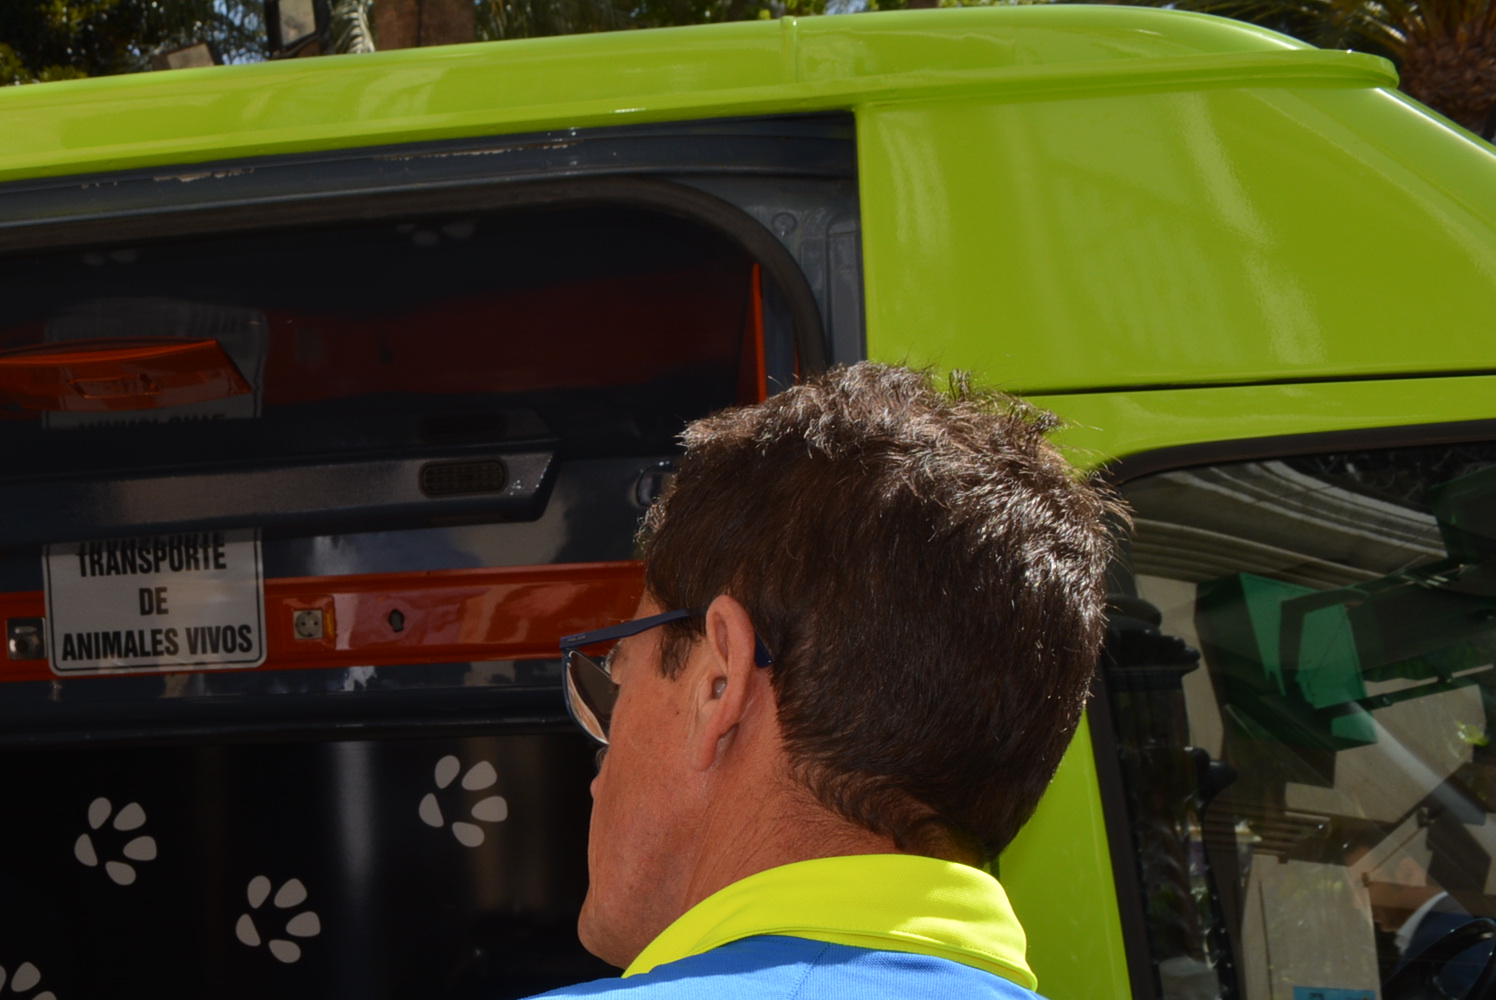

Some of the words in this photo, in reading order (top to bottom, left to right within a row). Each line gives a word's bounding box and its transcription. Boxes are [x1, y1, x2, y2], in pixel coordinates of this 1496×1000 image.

[76, 540, 227, 577] TRANSPORTE
[138, 587, 169, 616] DE
[62, 628, 179, 661] ANIMALES
[186, 624, 252, 655] VIVOS
